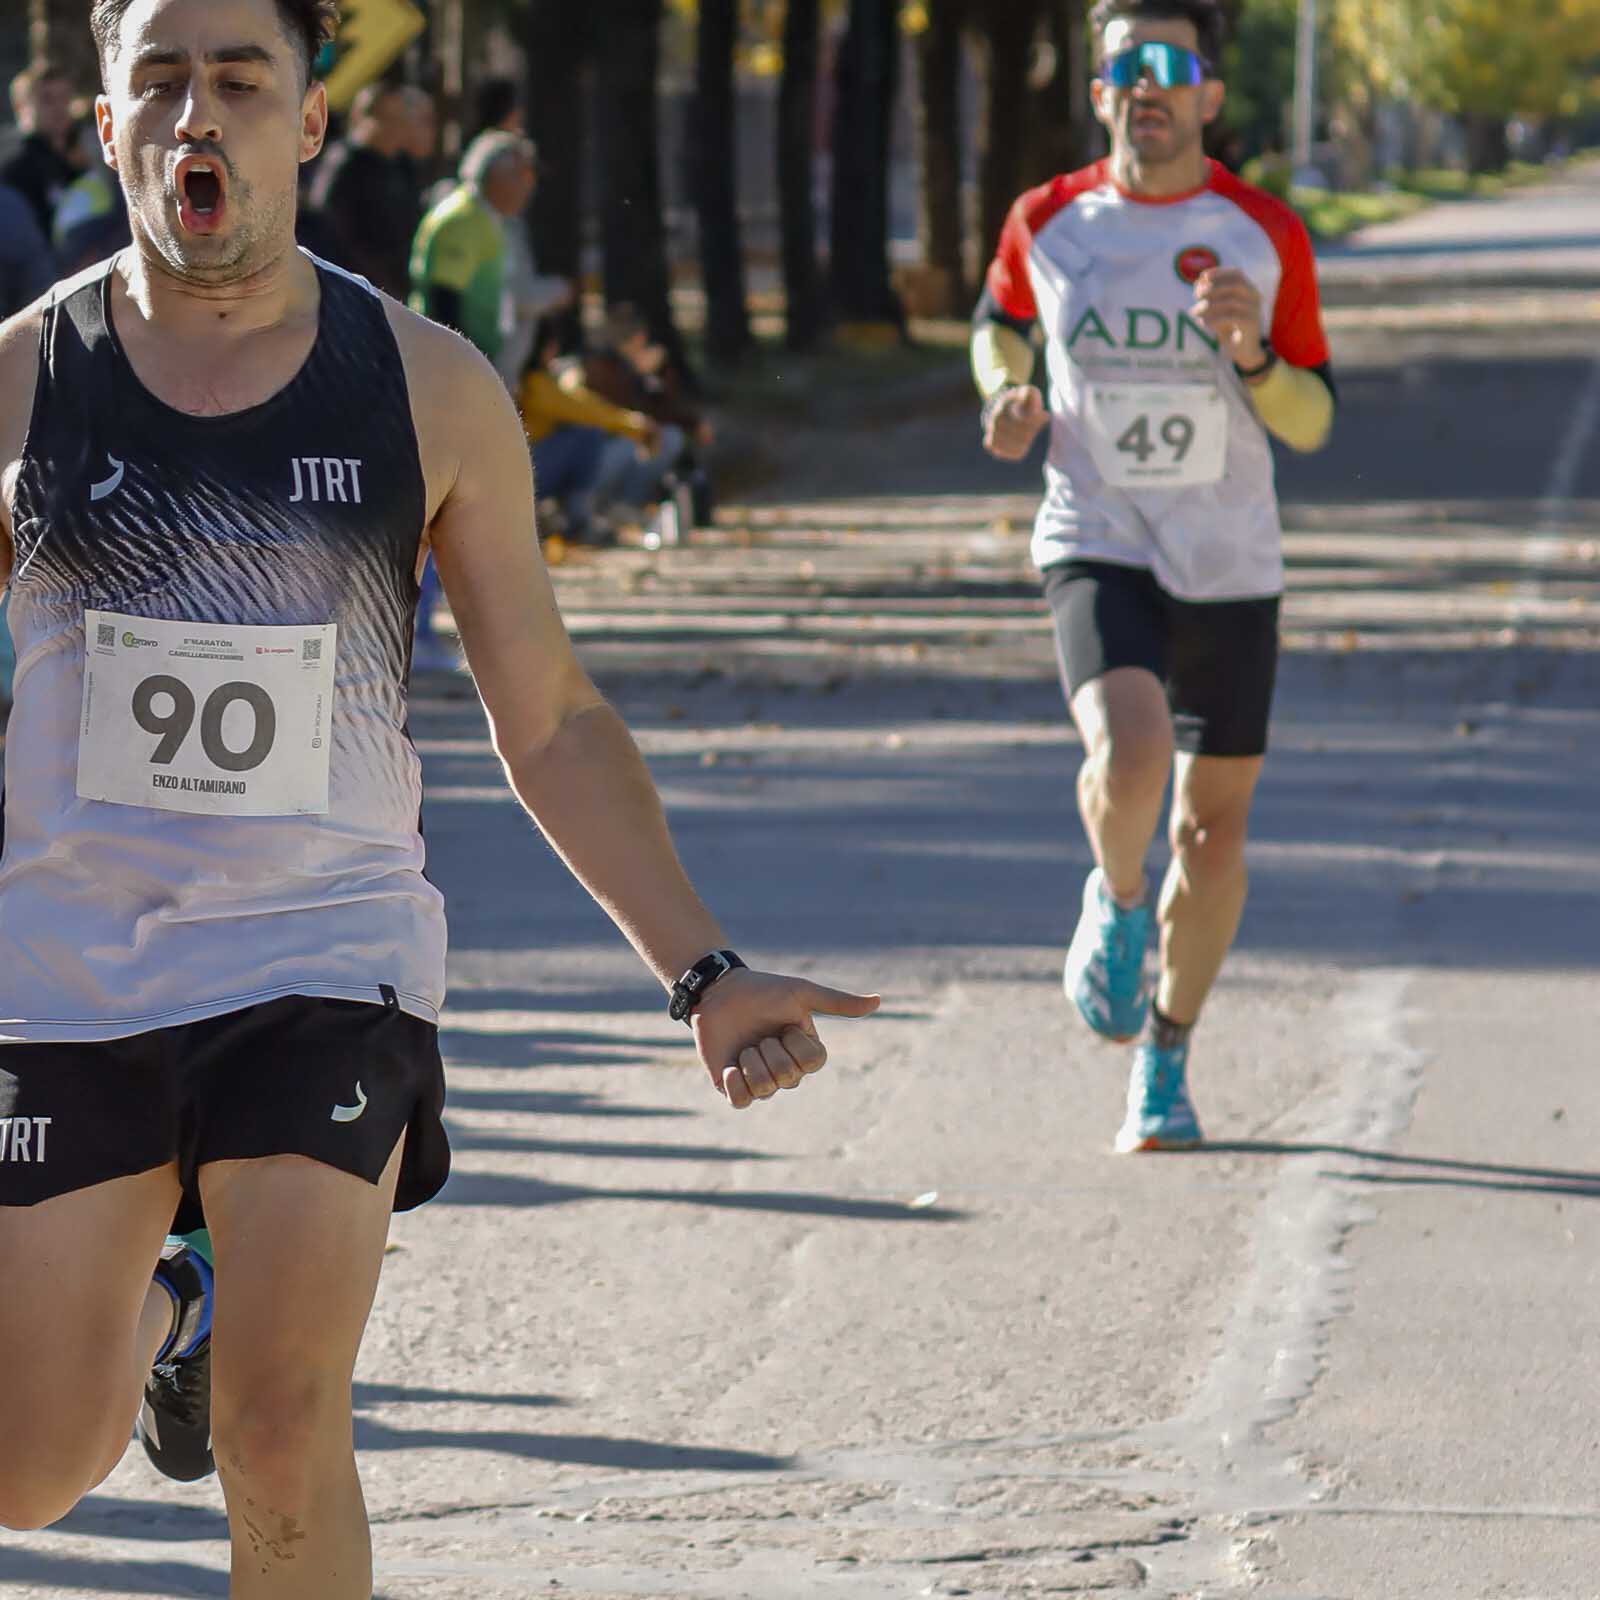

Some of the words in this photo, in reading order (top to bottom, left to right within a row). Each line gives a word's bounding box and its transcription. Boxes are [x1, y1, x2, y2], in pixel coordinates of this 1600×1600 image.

[1067, 305, 1220, 352] ADN
[1116, 413, 1196, 463] 49
[289, 457, 362, 504] JTRT
[131, 674, 276, 772] 90
[152, 774, 178, 790] ENZO
[180, 777, 246, 794] ALTAMIRANO
